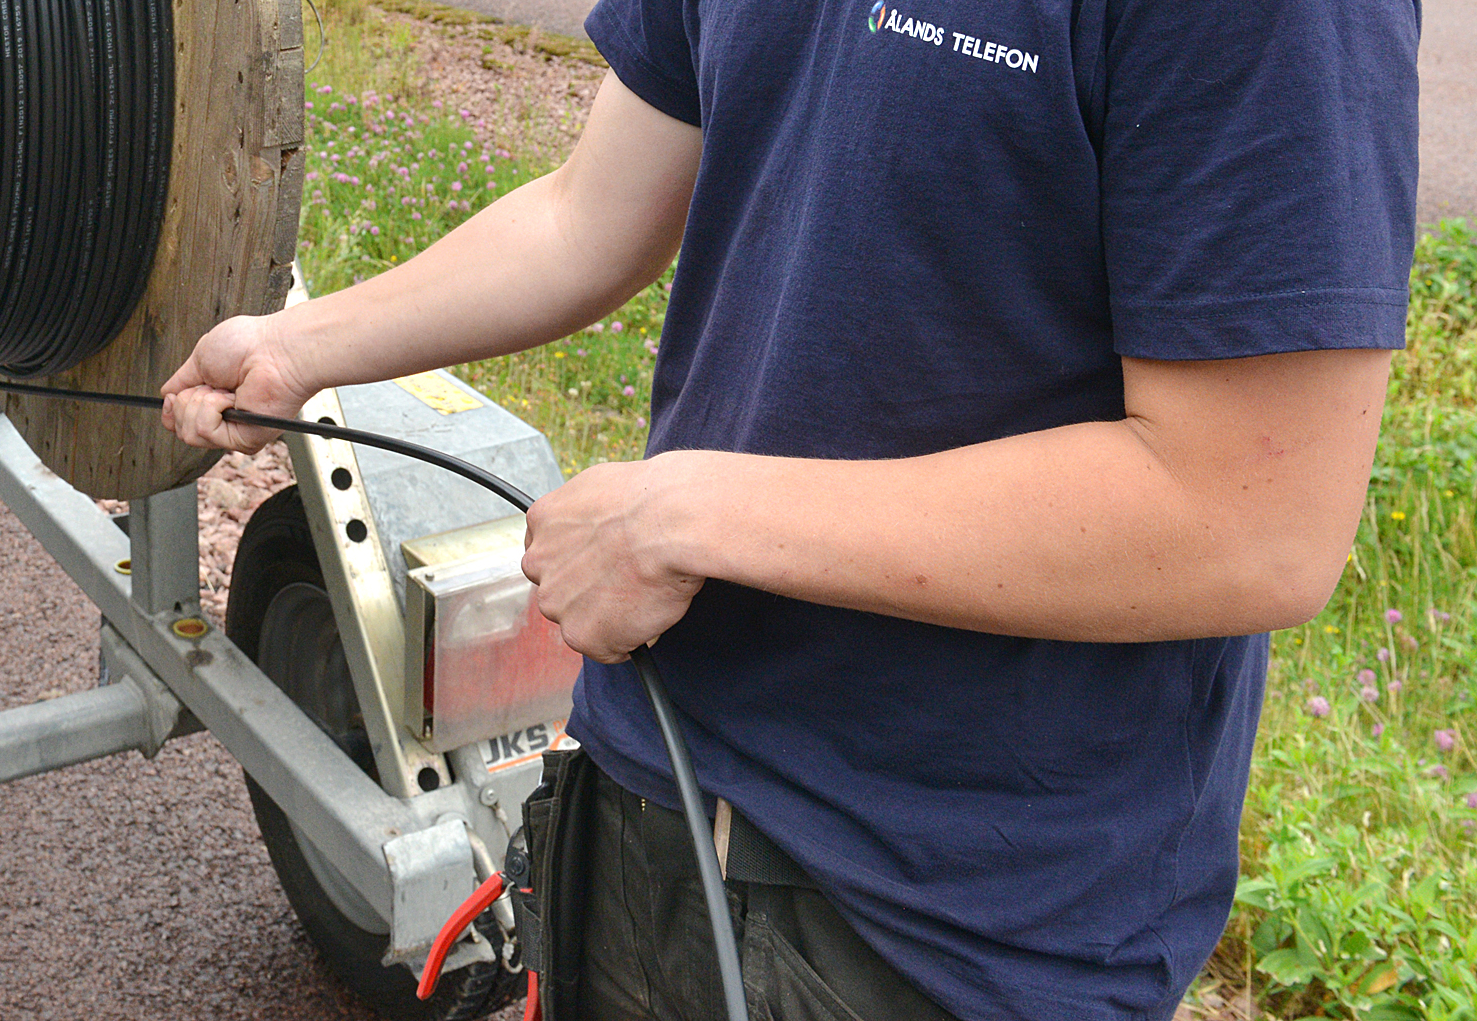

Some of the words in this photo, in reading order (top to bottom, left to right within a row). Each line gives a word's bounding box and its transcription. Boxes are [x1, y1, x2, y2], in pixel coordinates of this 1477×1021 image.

[884, 8, 944, 46] ÅLANDS
[952, 31, 1039, 73] TELEFON
[486, 723, 549, 765] JKS
